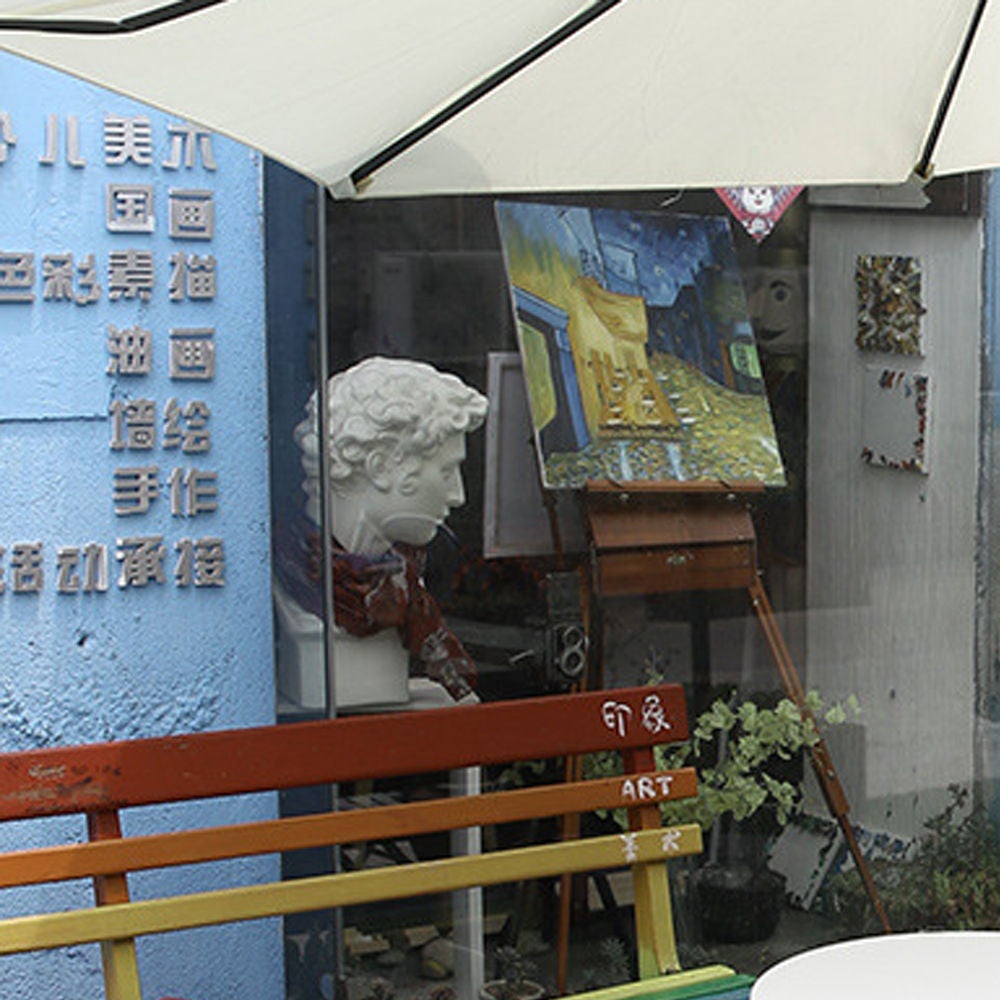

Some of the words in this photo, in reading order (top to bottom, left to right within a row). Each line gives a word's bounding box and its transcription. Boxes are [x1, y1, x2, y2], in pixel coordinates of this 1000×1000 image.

[106, 183, 215, 240] 国画
[0, 249, 217, 306] 色彩素描
[106, 323, 216, 379] 油画
[109, 397, 211, 454] 墙绘
[113, 465, 218, 517] 手作
[622, 776, 674, 800] ART
